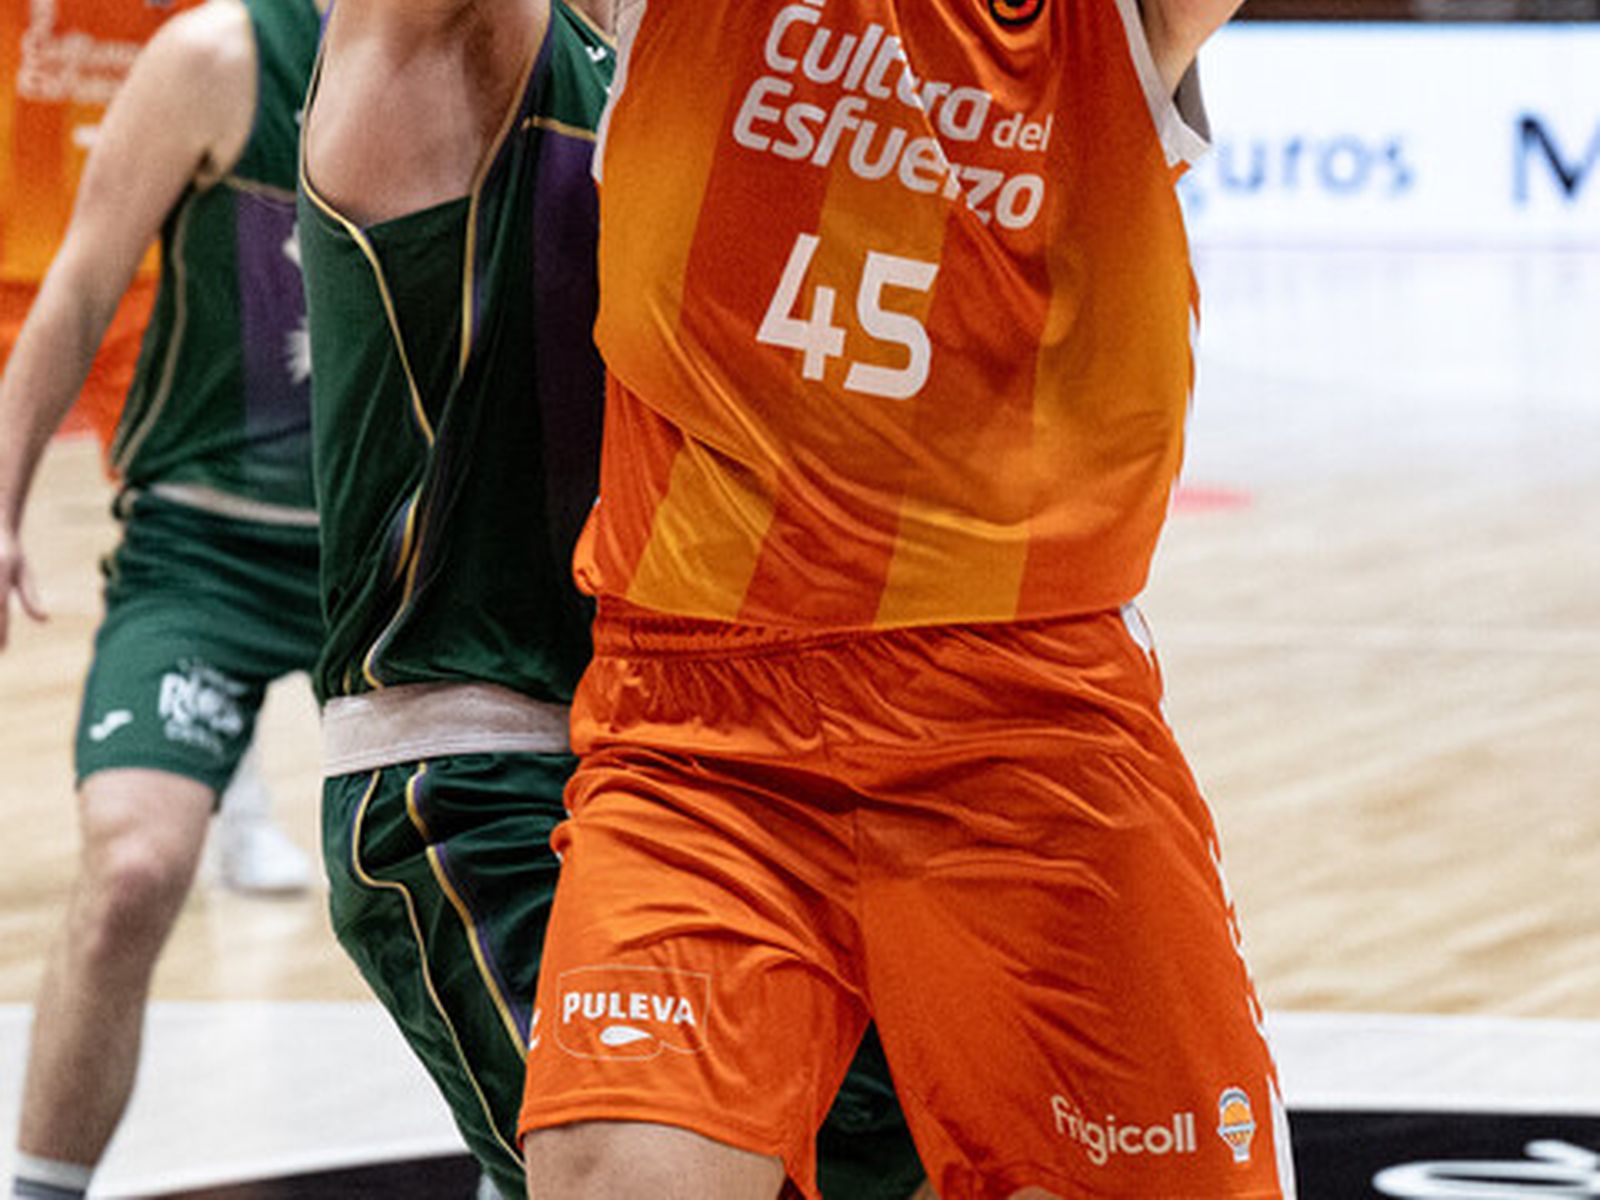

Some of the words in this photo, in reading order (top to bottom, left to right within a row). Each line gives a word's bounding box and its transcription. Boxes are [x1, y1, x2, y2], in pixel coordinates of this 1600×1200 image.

[764, 4, 993, 142] Cultura
[992, 112, 1055, 152] del
[732, 75, 1046, 230] Esfuerzo
[1186, 134, 1416, 212] uros
[756, 232, 940, 400] 45
[562, 991, 697, 1026] PULEVA
[1051, 1095, 1197, 1166] frigicoll
